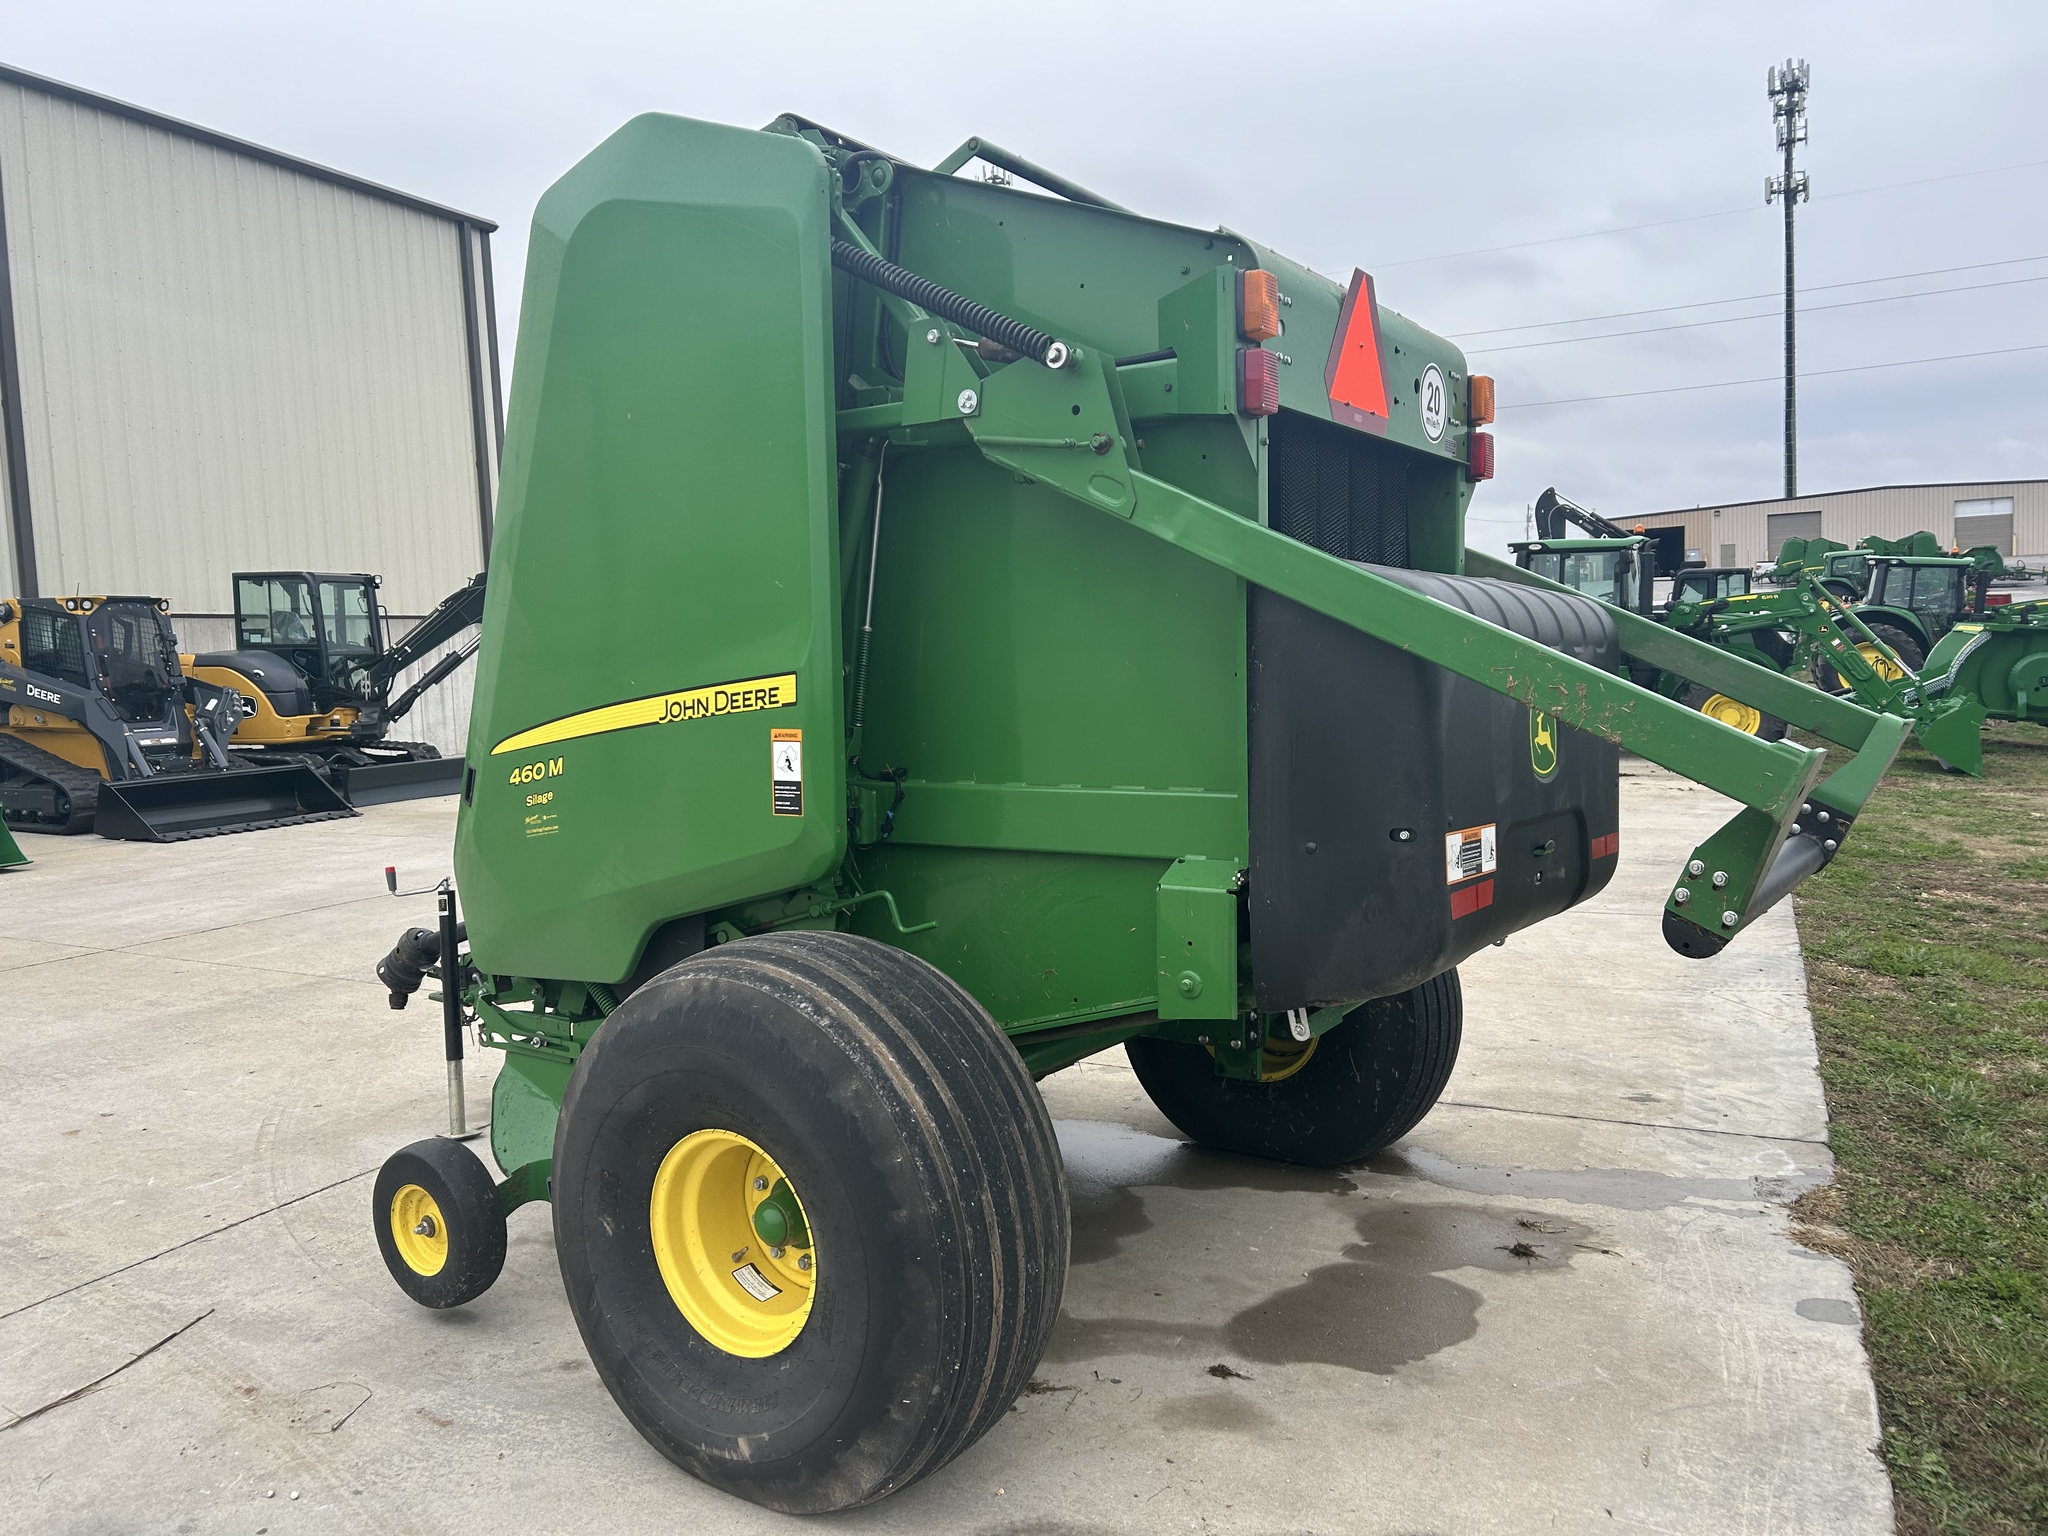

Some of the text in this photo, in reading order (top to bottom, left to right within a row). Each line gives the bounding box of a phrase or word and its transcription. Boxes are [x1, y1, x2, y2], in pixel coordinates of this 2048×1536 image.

[1427, 381, 1440, 416] 20
[26, 683, 61, 705] DEERE
[659, 686, 780, 721] JOHN DEERE
[509, 756, 564, 786] 460 M
[526, 791, 554, 807] Silage
